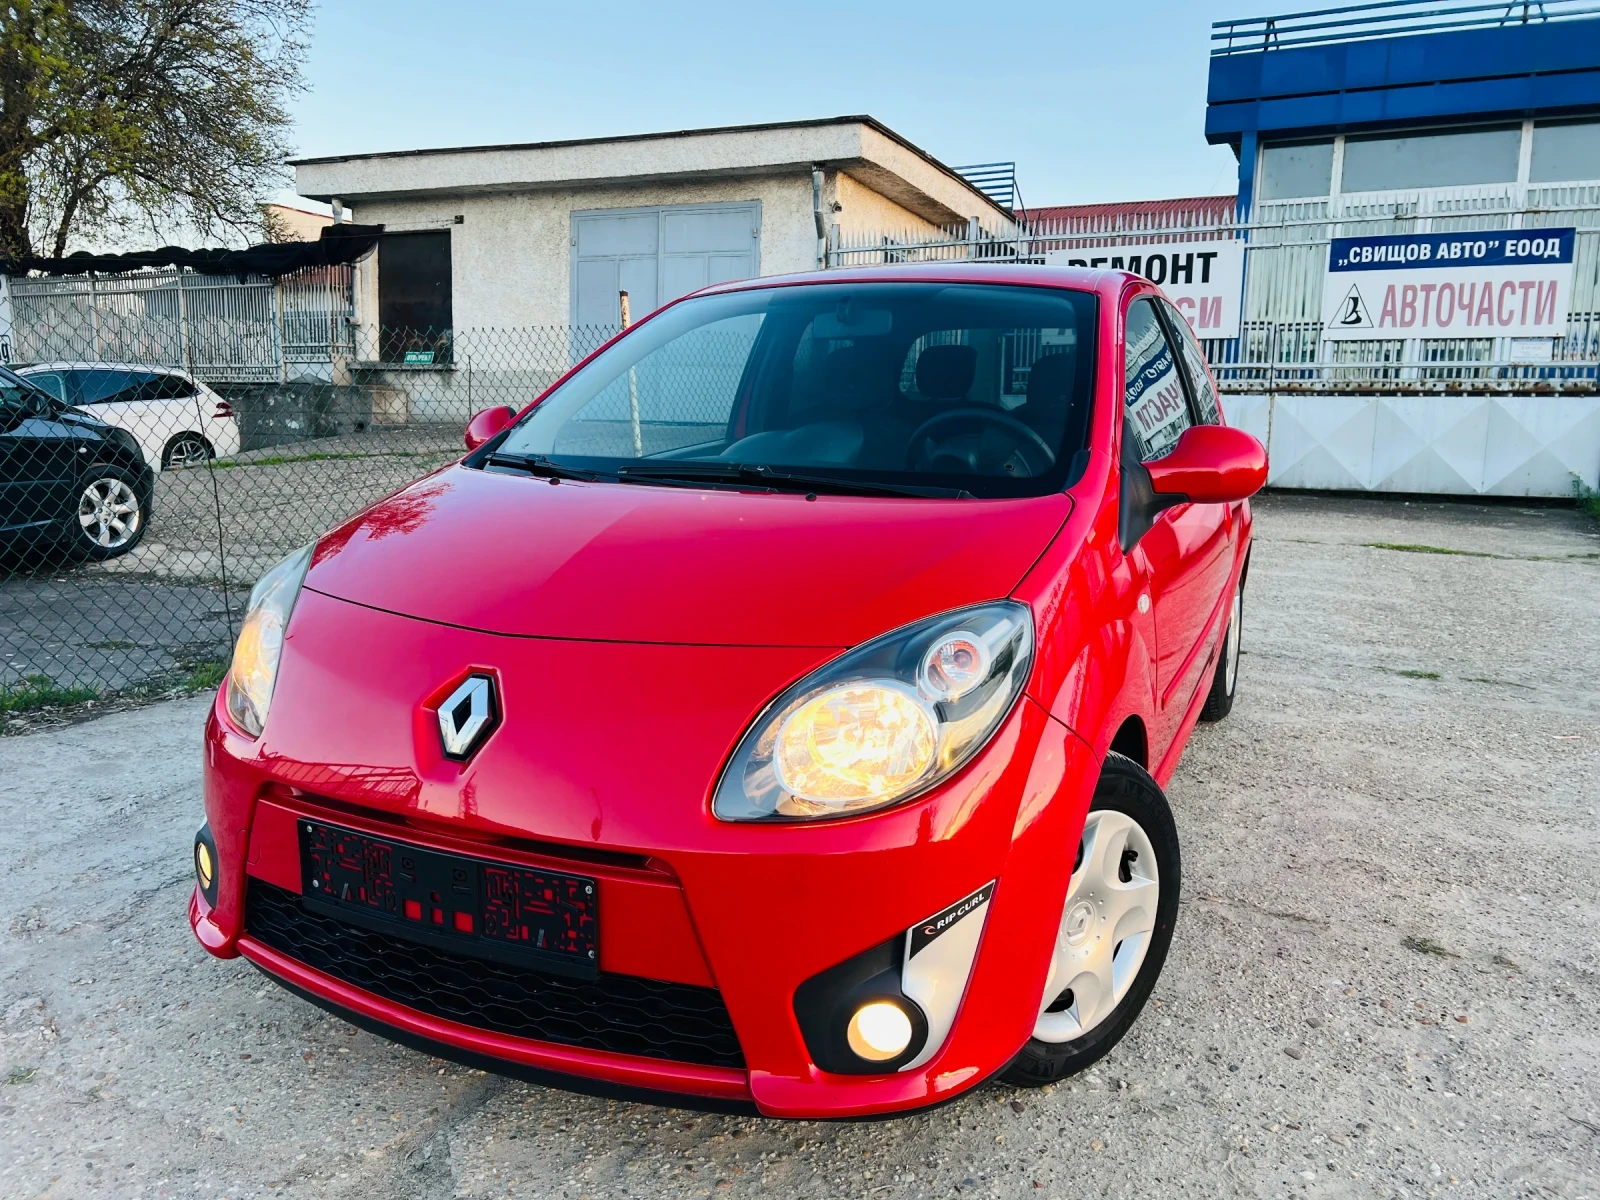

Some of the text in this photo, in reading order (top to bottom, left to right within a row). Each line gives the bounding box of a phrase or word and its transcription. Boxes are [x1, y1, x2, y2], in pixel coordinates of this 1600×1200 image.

[1505, 238, 1560, 259] ЕООД
[1378, 280, 1558, 328] АВТОЧАСТИ
[936, 893, 985, 930] RIP CURL
